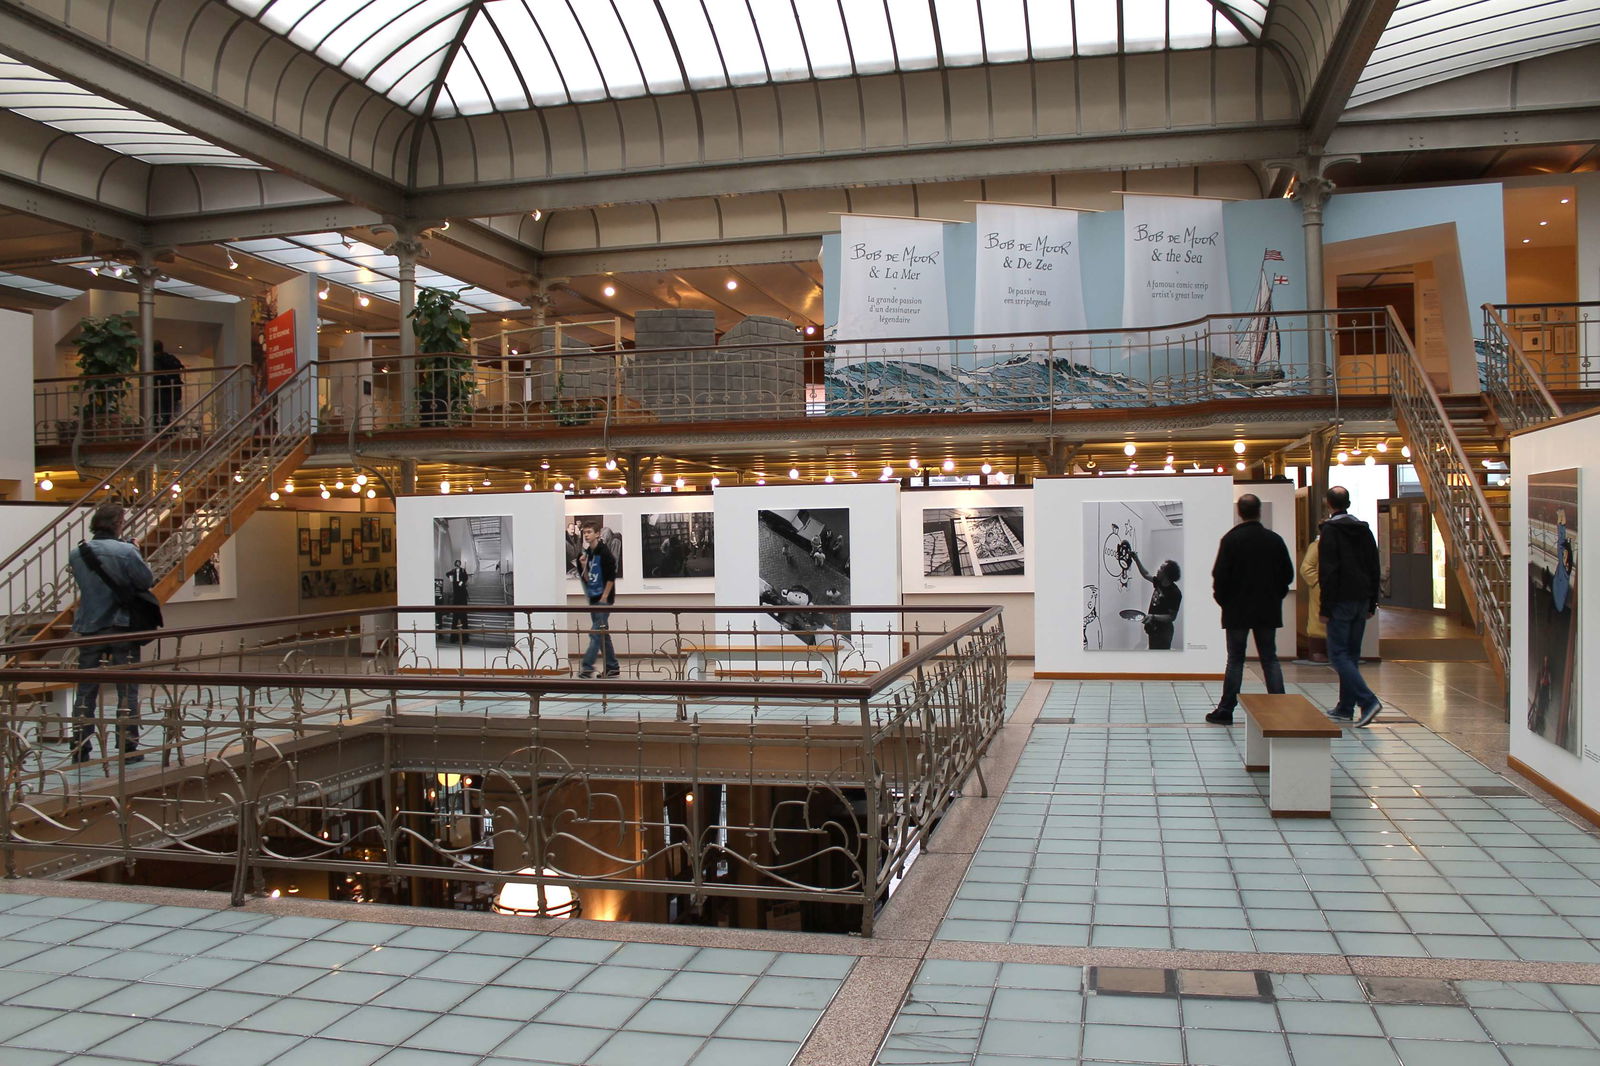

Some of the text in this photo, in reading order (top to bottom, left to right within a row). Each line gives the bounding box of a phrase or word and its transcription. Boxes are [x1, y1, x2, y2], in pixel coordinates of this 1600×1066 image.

[1134, 224, 1219, 249] BOB DE MOOR
[984, 232, 1072, 257] BOB DE MOOR
[850, 243, 940, 267] BOB DE MOOR
[1151, 248, 1203, 264] & the Sea
[1003, 256, 1053, 271] & De Zee
[869, 265, 921, 281] & La Mer
[1146, 280, 1209, 292] A famous comic strip
[1015, 288, 1035, 297] passie
[1036, 289, 1047, 297] van
[1151, 290, 1204, 302] artist's great love
[867, 295, 922, 306] La grande passion
[1014, 297, 1052, 308] striplegende
[869, 305, 921, 315] d'un dessinateur
[879, 315, 911, 325] légendaire
